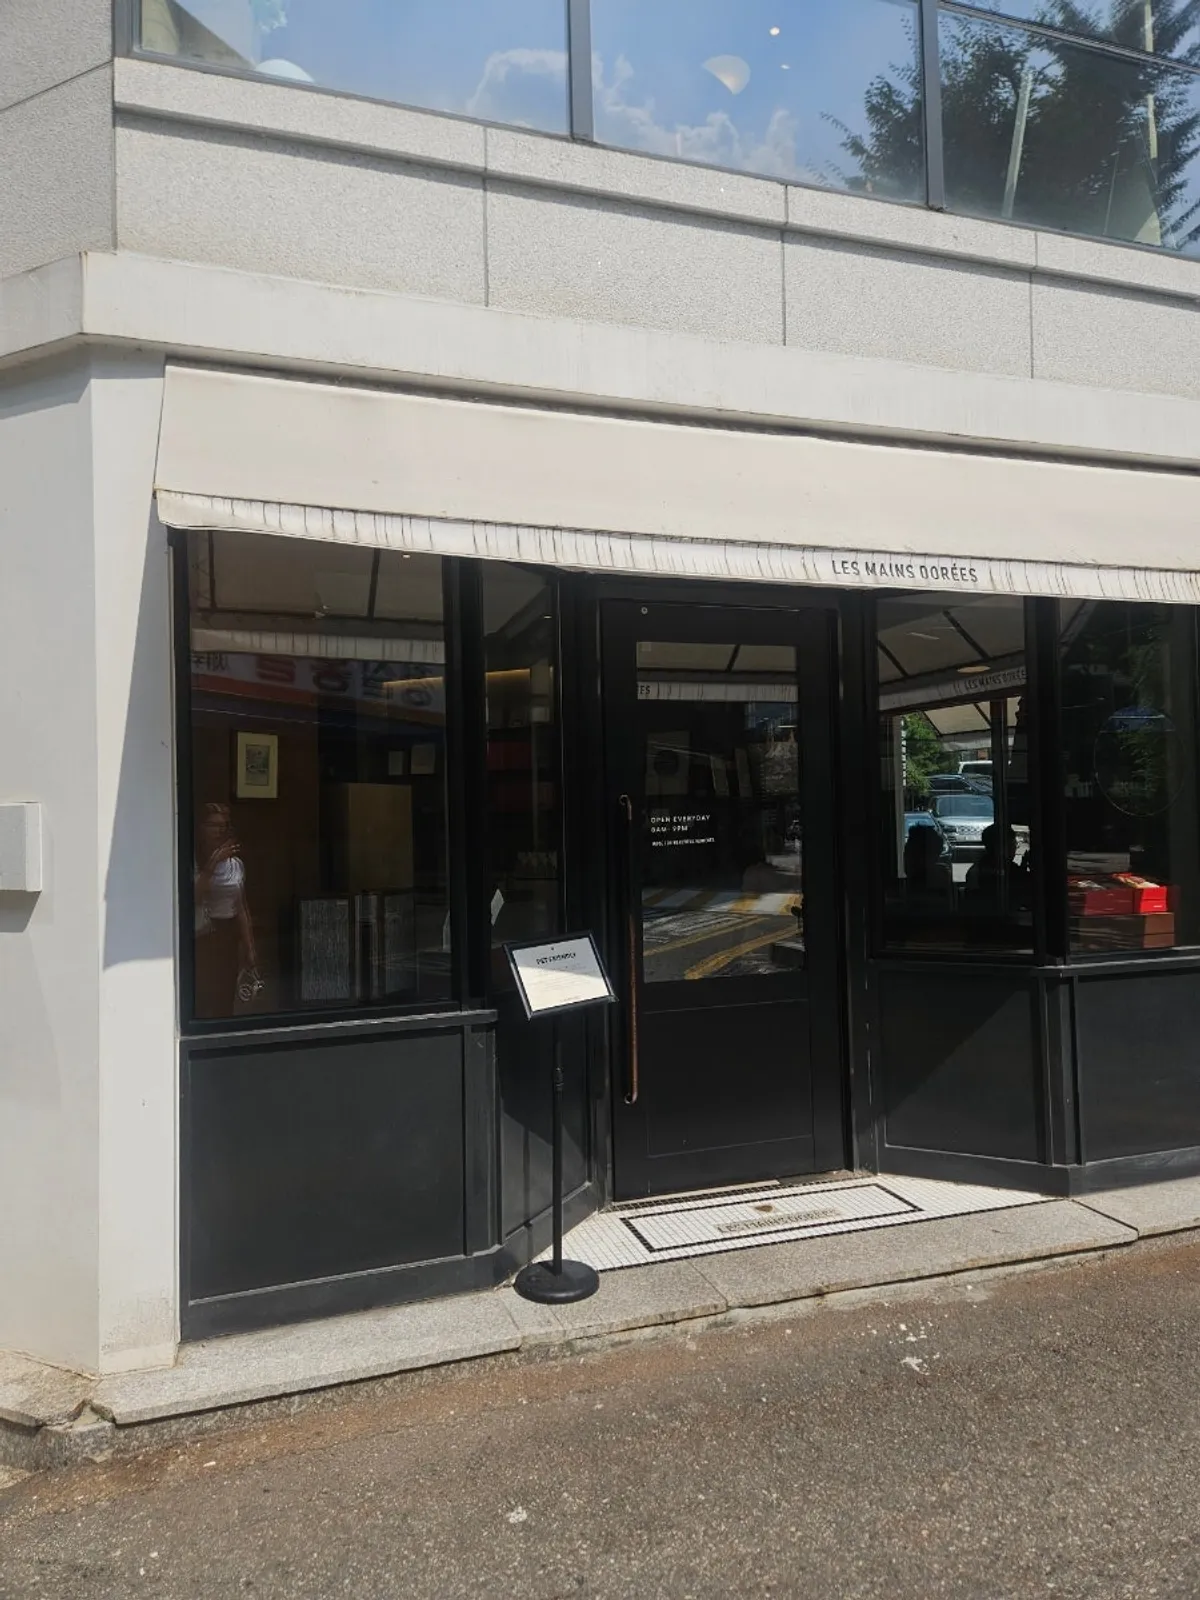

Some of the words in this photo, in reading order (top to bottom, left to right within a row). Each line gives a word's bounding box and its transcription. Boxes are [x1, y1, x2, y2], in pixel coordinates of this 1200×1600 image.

[831, 560, 860, 576] LES
[864, 561, 916, 579] MAINS
[919, 563, 978, 583] DORÉES
[651, 816, 671, 824] OPEN
[673, 814, 711, 823] EVERYDAY
